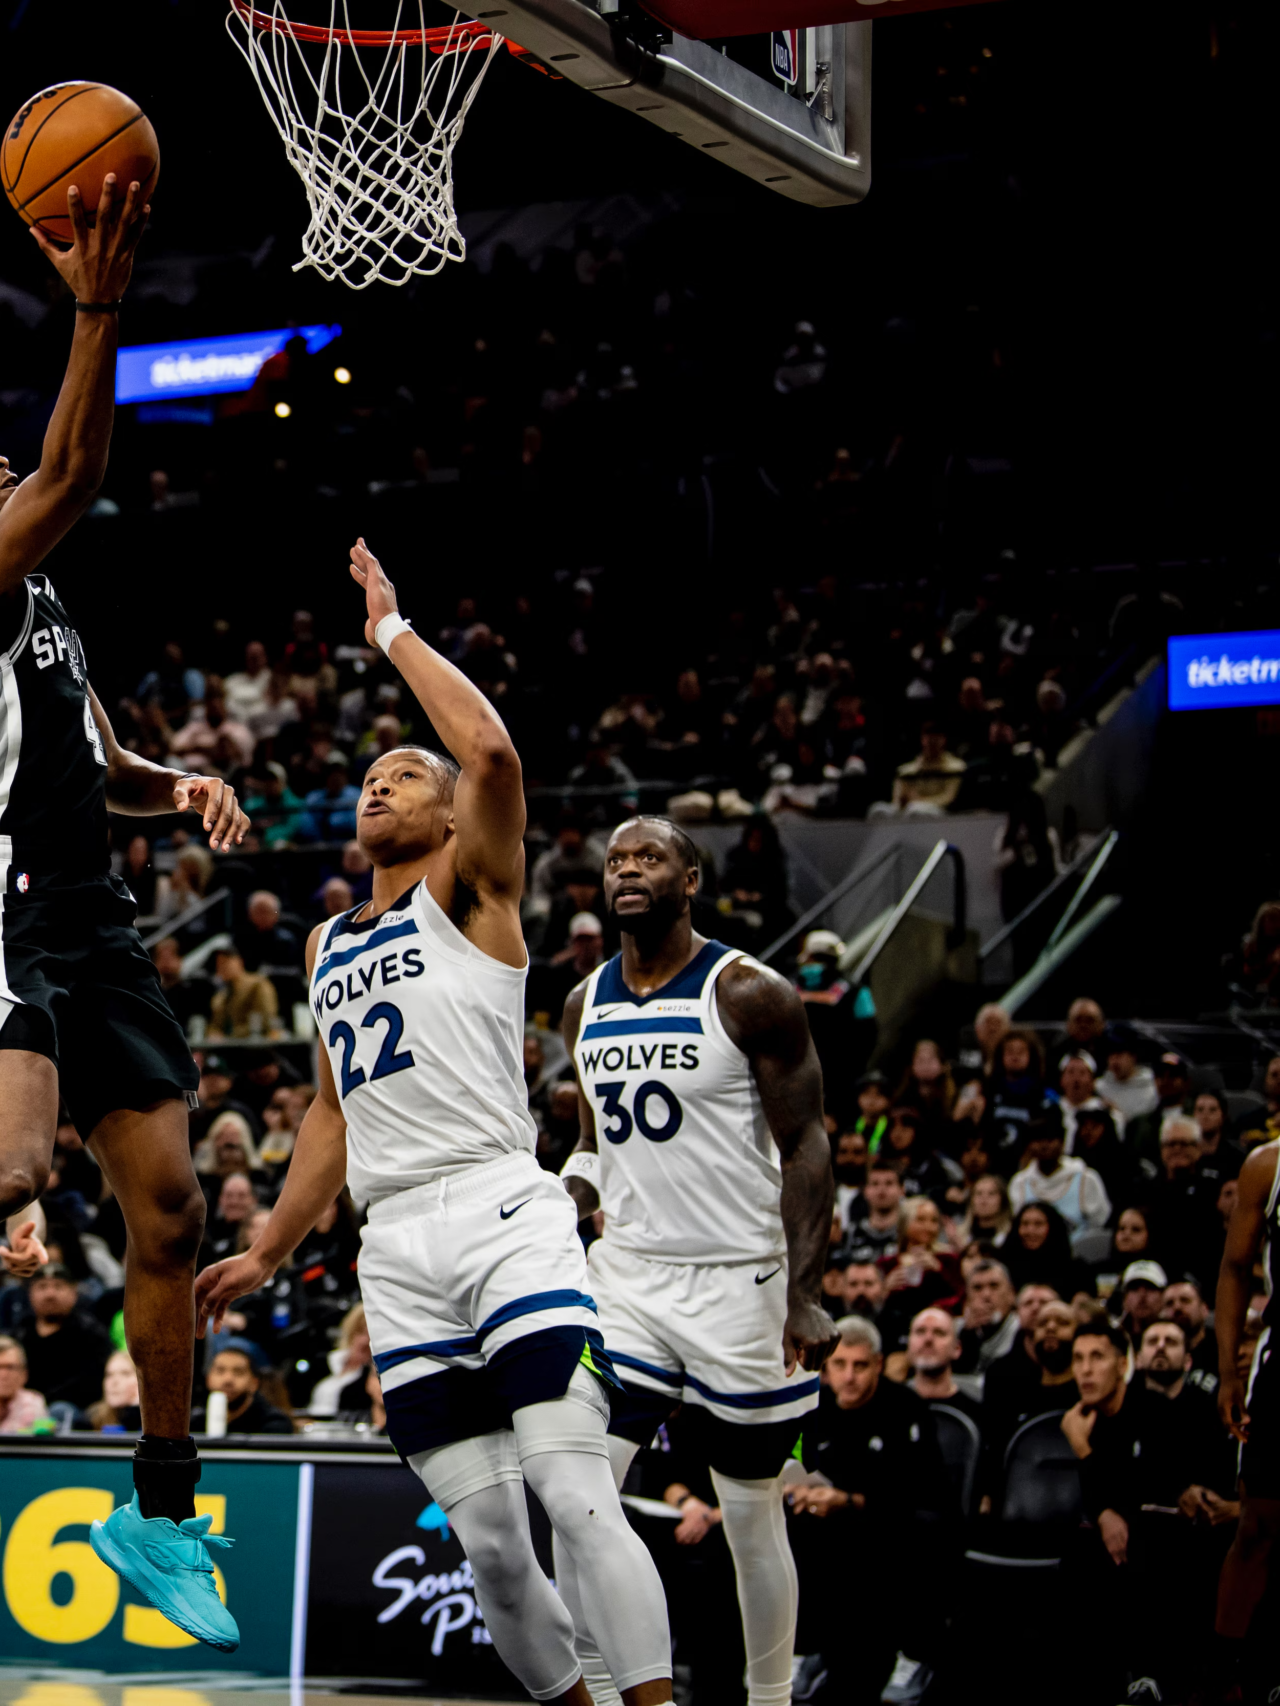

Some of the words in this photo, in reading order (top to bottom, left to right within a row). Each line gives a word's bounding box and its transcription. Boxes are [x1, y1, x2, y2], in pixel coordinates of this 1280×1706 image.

[775, 42, 789, 72] NBA
[313, 948, 426, 1022] WOLVES
[662, 1003, 692, 1013] sezzle
[328, 1000, 416, 1101] 22
[581, 1043, 700, 1077] WOLVES
[594, 1079, 684, 1145] 30
